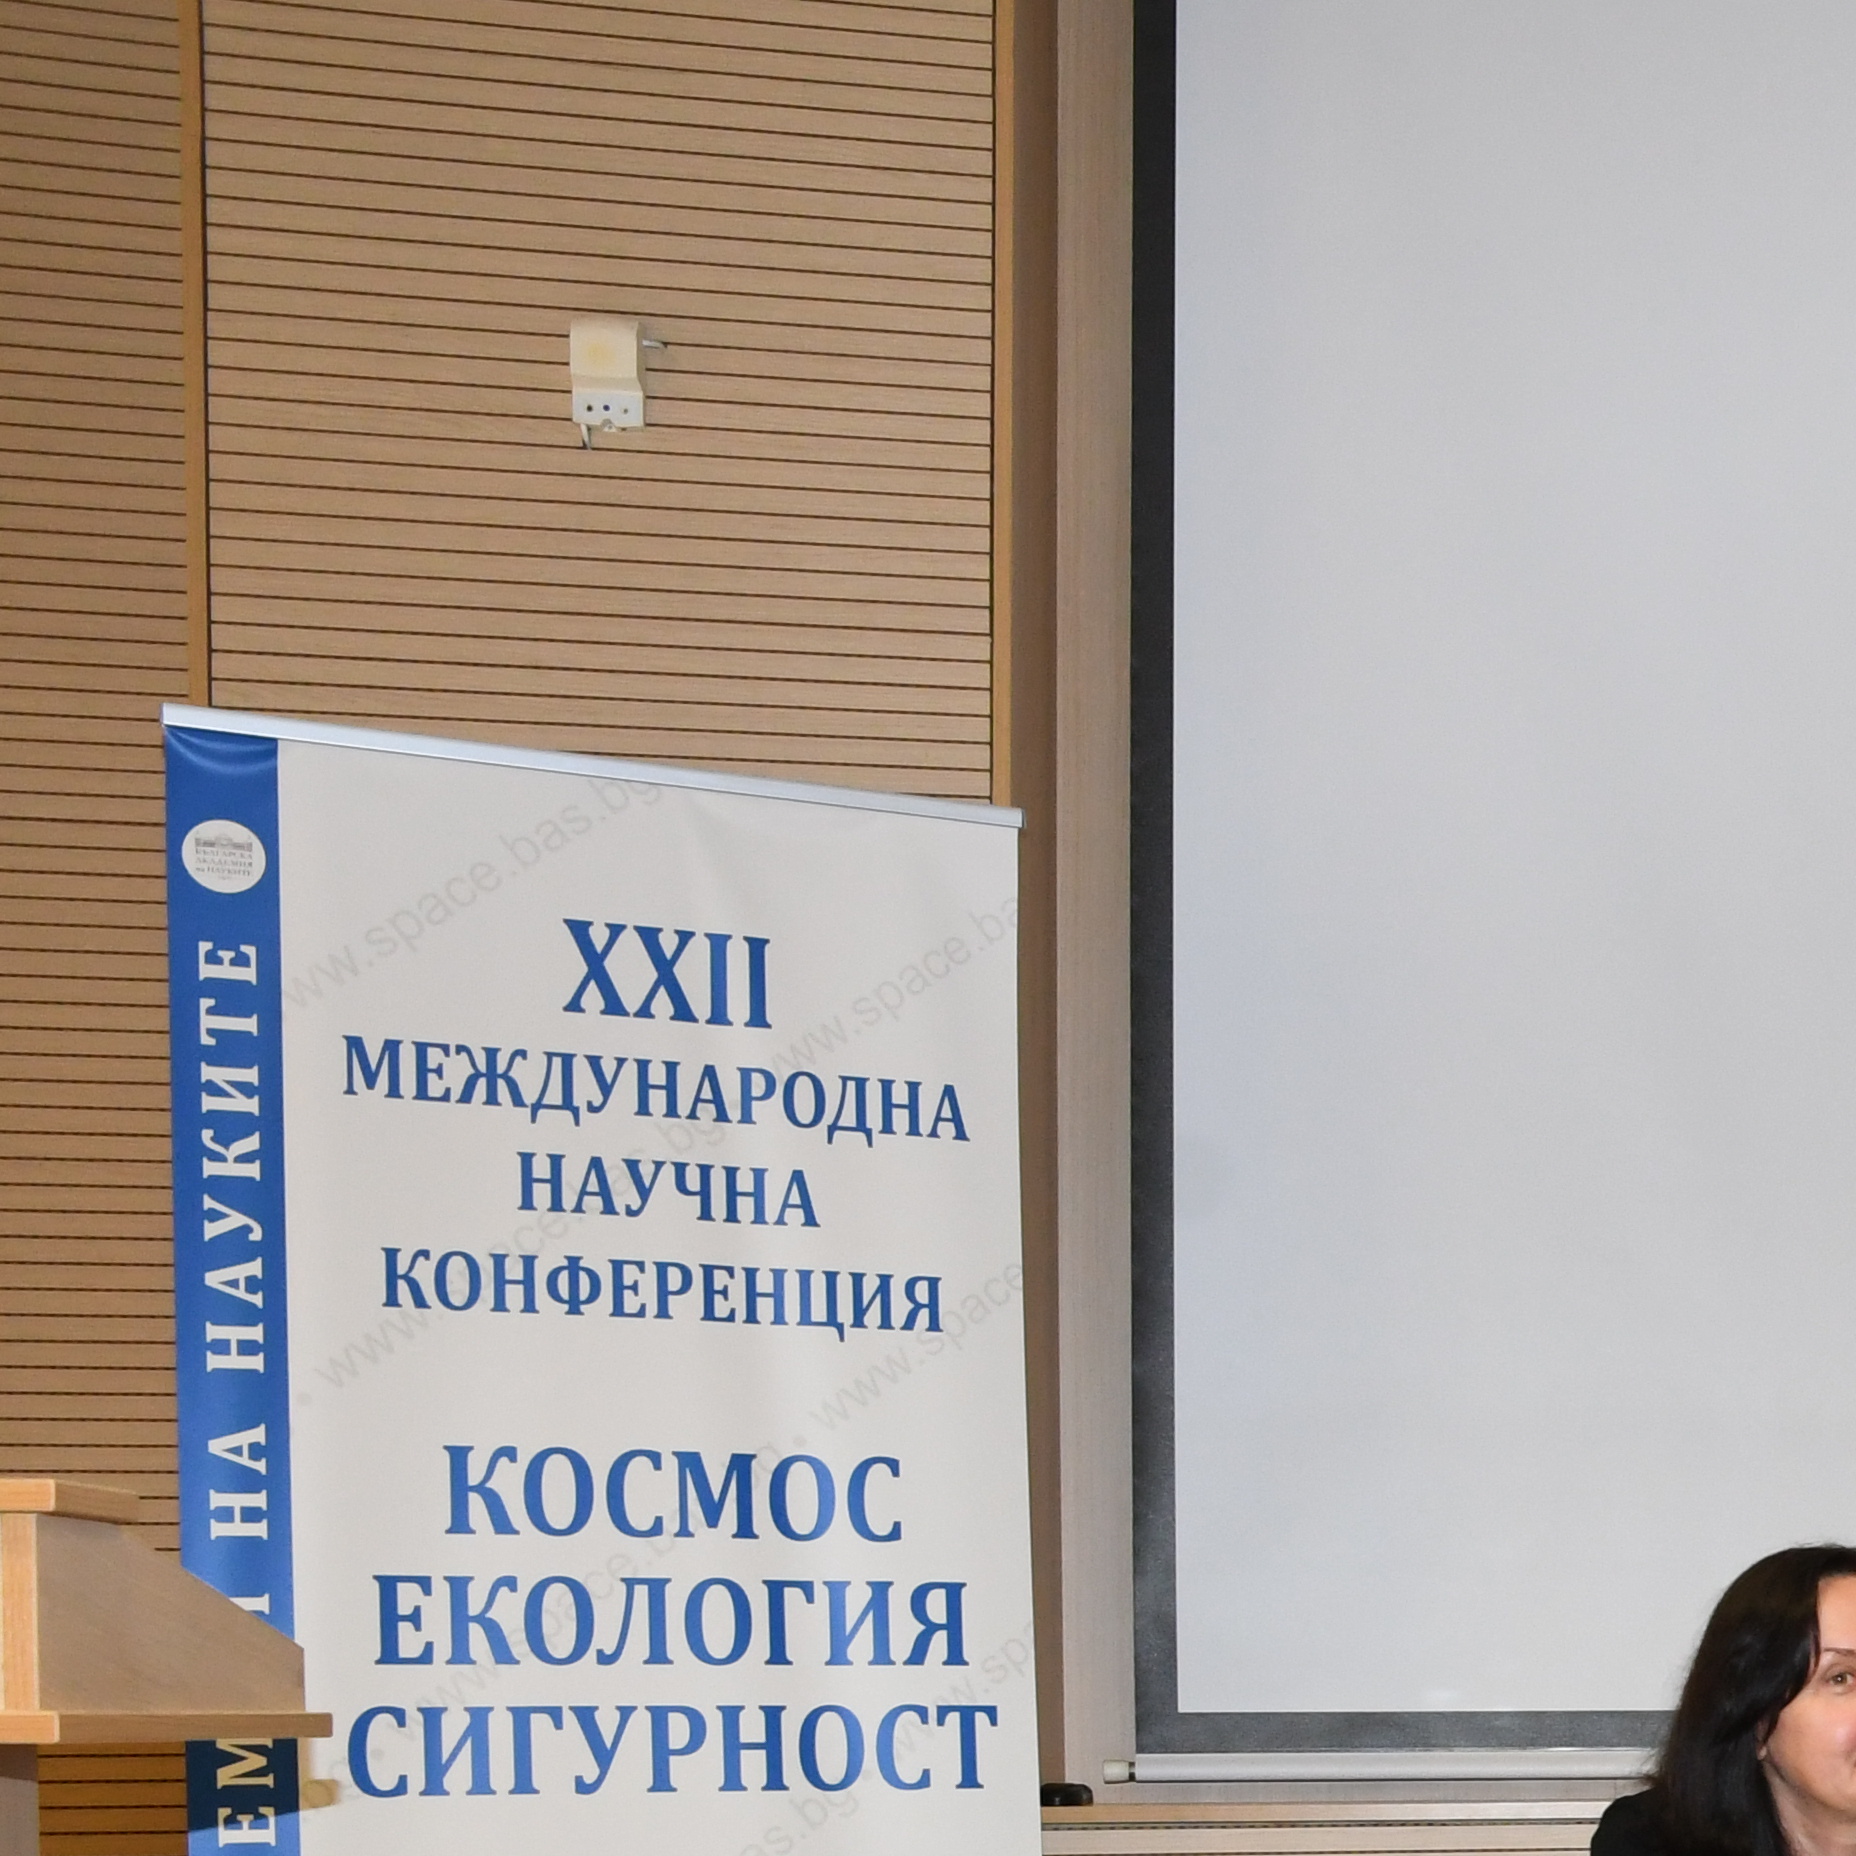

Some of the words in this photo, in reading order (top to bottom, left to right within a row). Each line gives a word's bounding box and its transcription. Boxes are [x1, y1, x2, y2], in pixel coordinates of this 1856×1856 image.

[562, 917, 773, 1030] XXII
[343, 1034, 970, 1145] МЕЖДУНАРОДНА
[198, 940, 265, 1374] НАУКИТЕ
[517, 1150, 820, 1228] НАУЧНА
[381, 1246, 943, 1342] КОНФЕРЕНЦИЯ
[208, 1423, 268, 1540] НА
[443, 1444, 903, 1543] КОСМОС
[373, 1573, 968, 1667] ЕКОЛОГИЯ
[347, 1703, 999, 1799] СИГУРНОСТ
